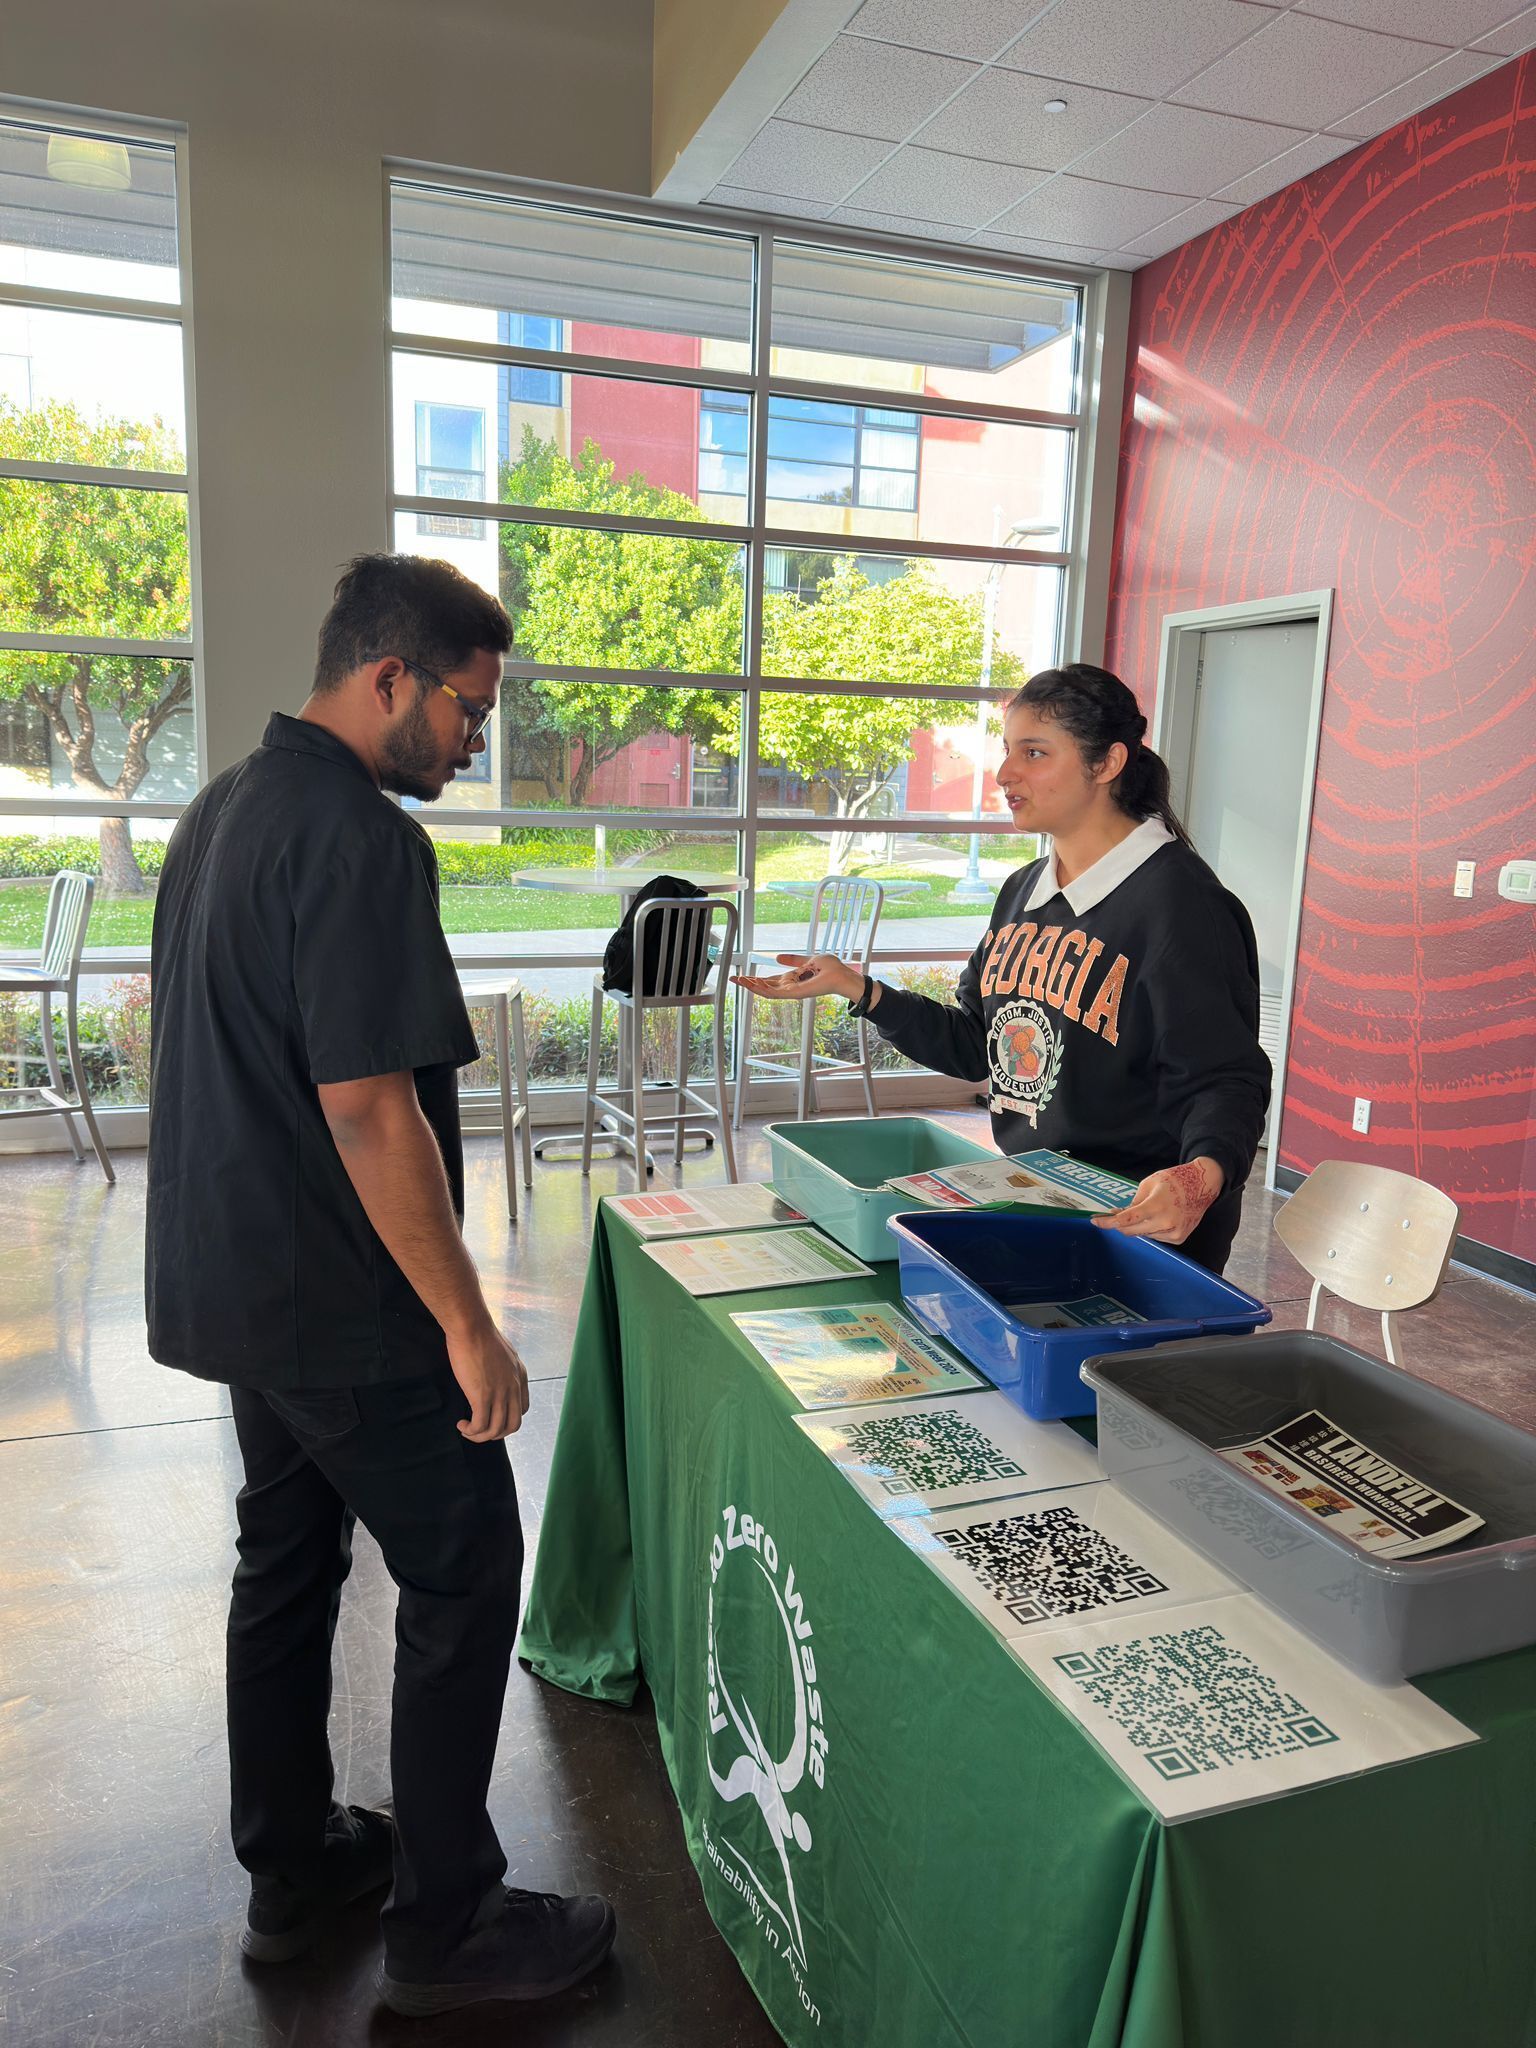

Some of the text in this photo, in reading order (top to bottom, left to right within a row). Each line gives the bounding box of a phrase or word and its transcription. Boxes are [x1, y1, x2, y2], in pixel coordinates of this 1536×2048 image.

[980, 921, 1130, 1048] EORGIA
[991, 1007, 1026, 1040] WISDOM,
[993, 1063, 1047, 1093] MODERATION
[1001, 1097, 1022, 1111] EST.
[1054, 1162, 1137, 1199] RECYCLE
[911, 1338, 960, 1375] Earth Week 2024
[1303, 1449, 1360, 1486] BASURERO
[1355, 1482, 1418, 1524] MUNICIPAL
[1317, 1435, 1446, 1517] LANDFILL
[722, 1504, 779, 1574] Zero
[784, 1563, 829, 1790] Waste
[702, 1817, 765, 1927] tainability
[765, 1918, 780, 1950] in
